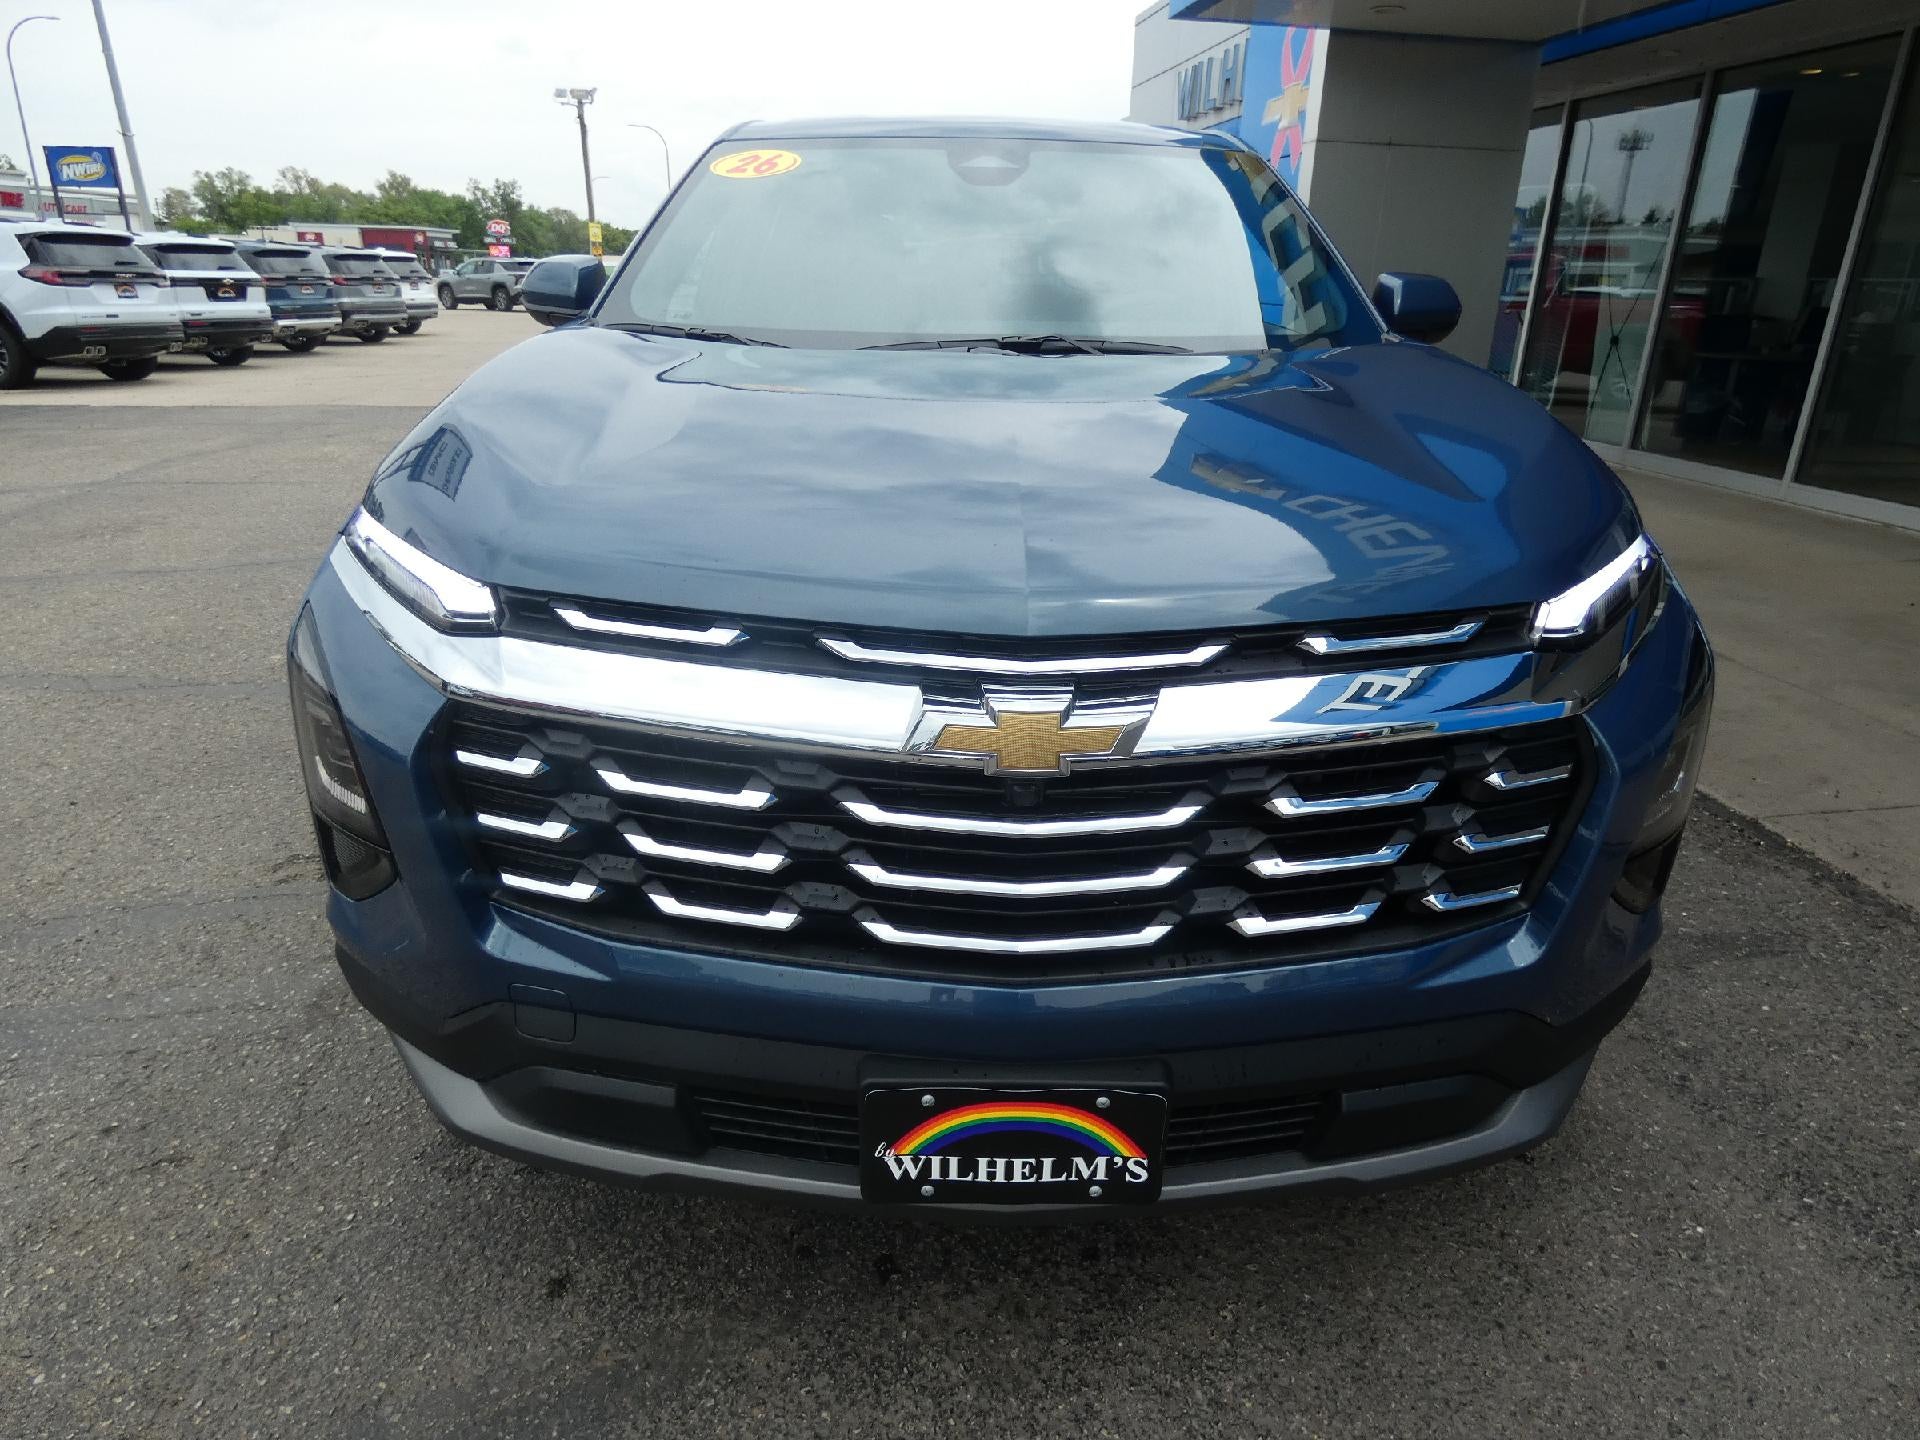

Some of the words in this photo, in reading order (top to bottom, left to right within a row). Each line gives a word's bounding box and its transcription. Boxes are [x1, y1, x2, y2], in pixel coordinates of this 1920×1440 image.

[1177, 38, 1249, 121] WILH
[725, 153, 783, 175] 26
[882, 1154, 1150, 1184] WILHELM'S
